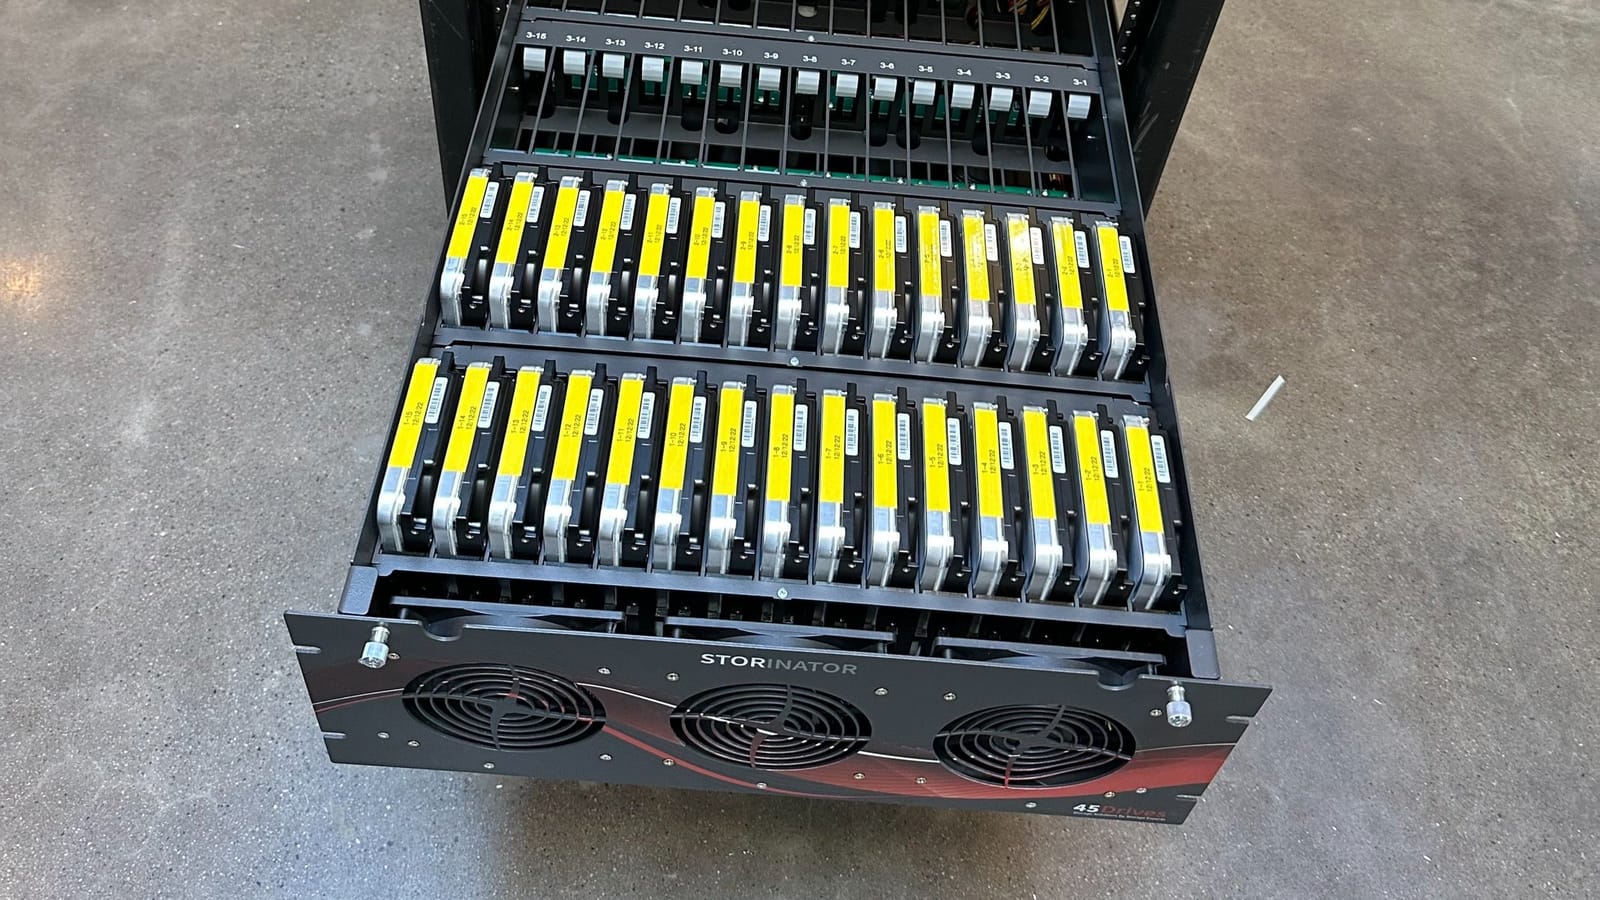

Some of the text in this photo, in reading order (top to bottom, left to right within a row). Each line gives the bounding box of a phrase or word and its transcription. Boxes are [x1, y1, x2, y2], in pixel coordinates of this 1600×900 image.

[526, 31, 547, 40] 3-15
[565, 35, 586, 43] 3-14
[605, 38, 626, 46] 3-13
[644, 41, 665, 50] 3-12
[683, 44, 703, 53] 3-11
[722, 48, 743, 57] 3-10
[764, 51, 779, 59] 3-9
[802, 55, 818, 63] 3-8
[879, 62, 895, 70] 3-6
[918, 65, 933, 73] 3-5
[995, 72, 1011, 80] 3-3
[1034, 75, 1050, 83] 3-2
[403, 412, 413, 425] 1-15
[458, 415, 466, 429] 1-14
[511, 420, 519, 434] 1-13
[617, 428, 625, 442] 1-11
[720, 442, 728, 452] 1-9
[701, 654, 857, 674] STORINATOR
